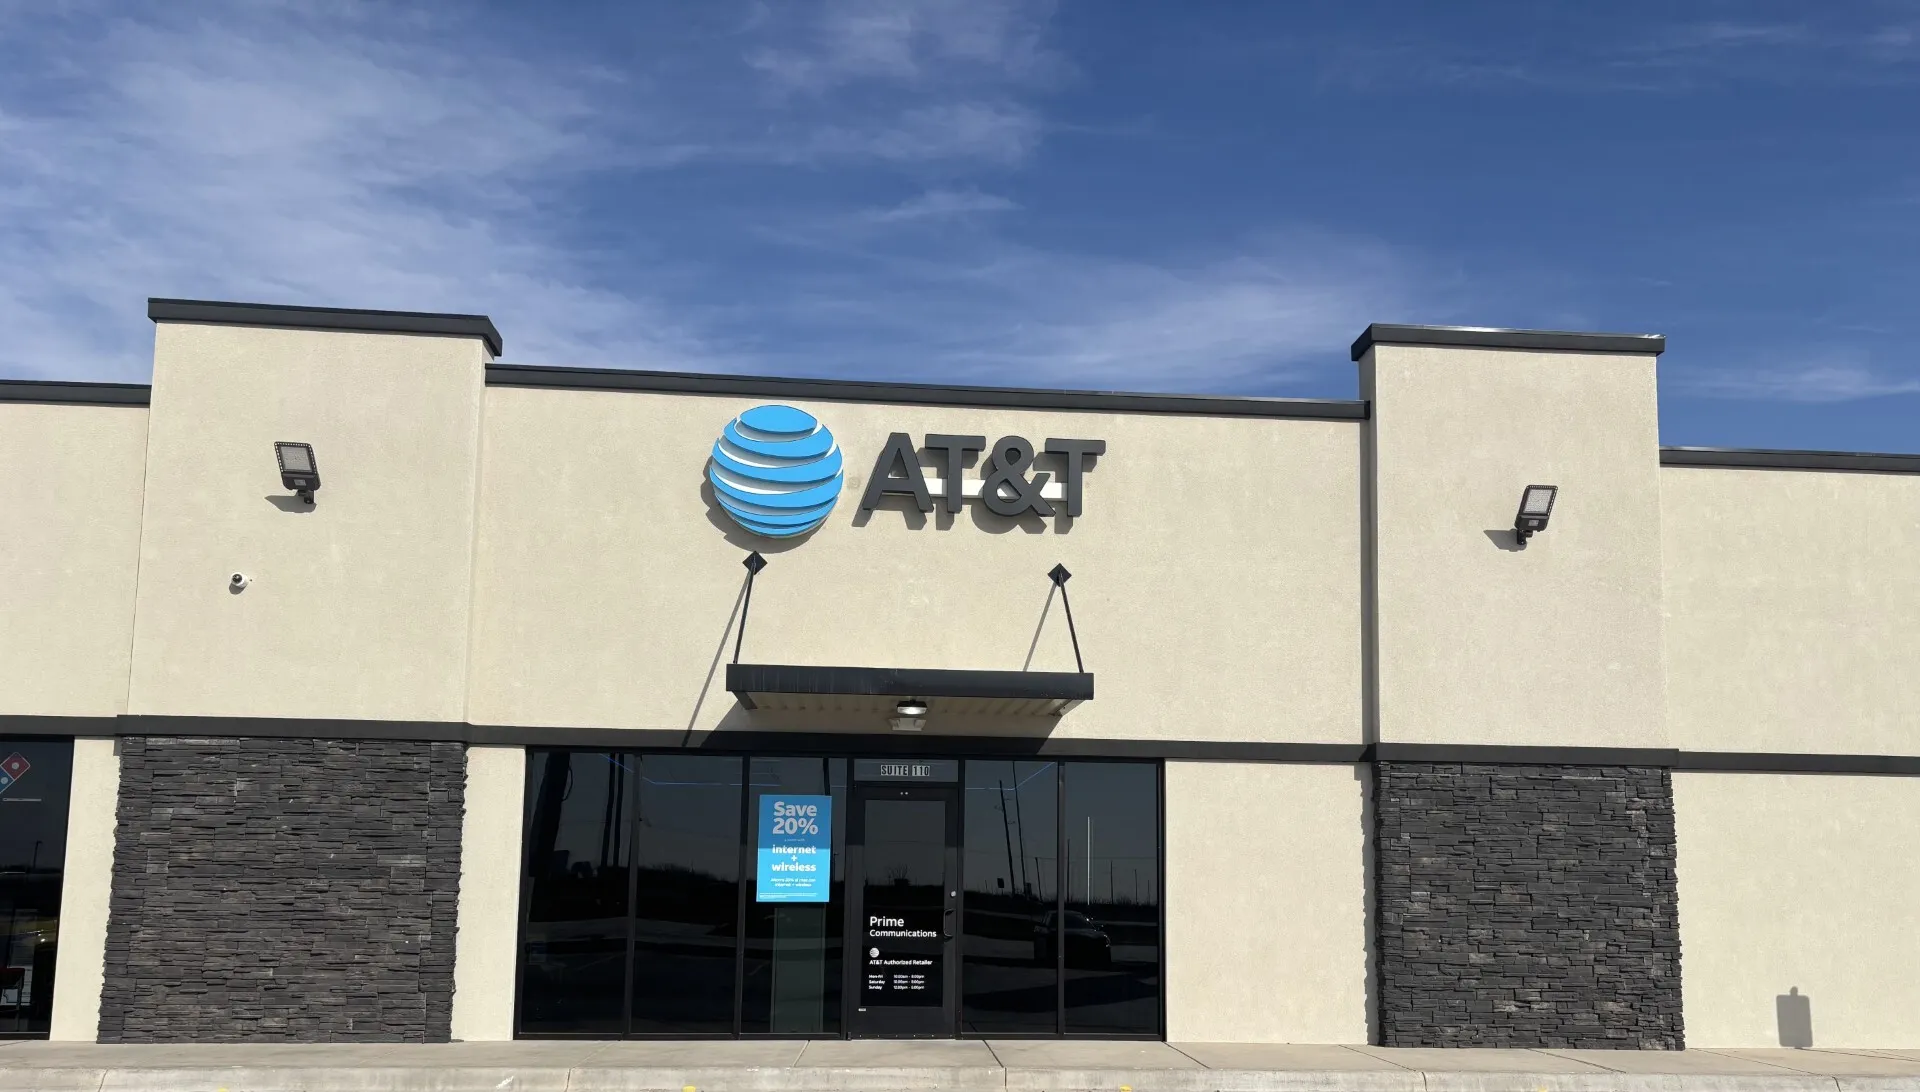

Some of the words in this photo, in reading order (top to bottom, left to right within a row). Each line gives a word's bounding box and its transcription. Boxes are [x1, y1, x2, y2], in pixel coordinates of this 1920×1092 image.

[862, 432, 1106, 518] AT&T
[881, 765, 908, 776] SUITE
[912, 765, 930, 776] 110
[773, 801, 818, 817] Save
[772, 817, 819, 835] 20%
[772, 844, 817, 854] internet
[771, 862, 817, 872] wireless
[869, 915, 905, 927] Prime
[869, 929, 937, 938] Communications
